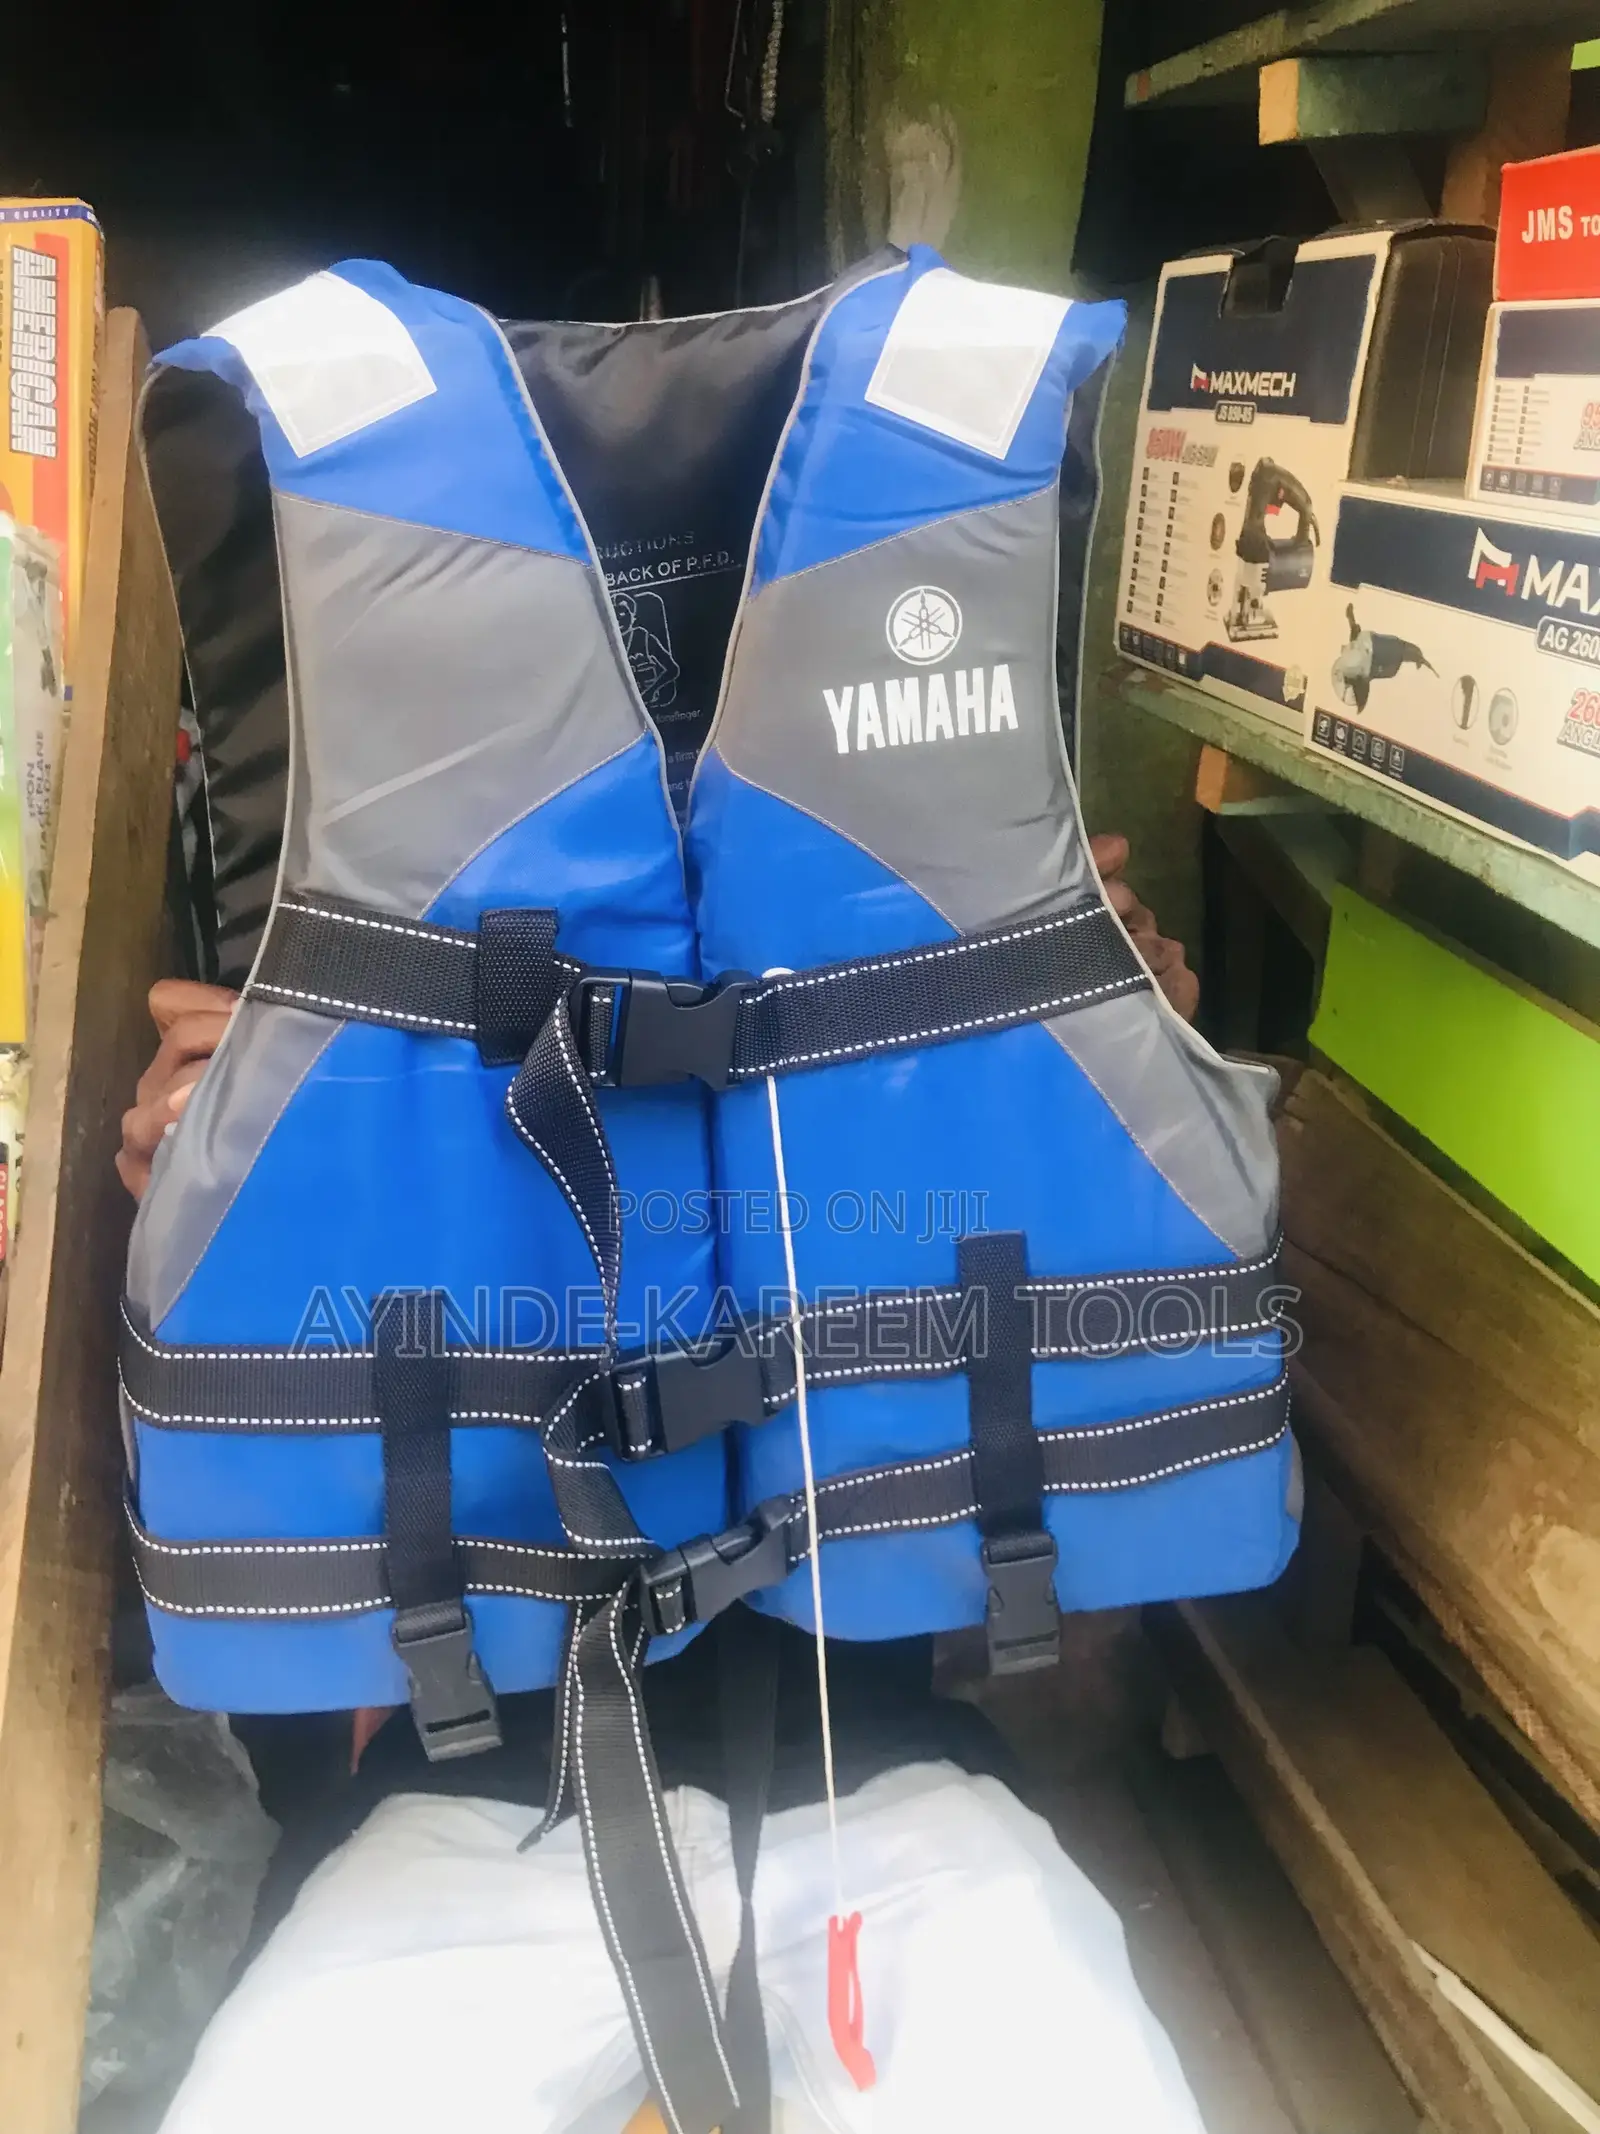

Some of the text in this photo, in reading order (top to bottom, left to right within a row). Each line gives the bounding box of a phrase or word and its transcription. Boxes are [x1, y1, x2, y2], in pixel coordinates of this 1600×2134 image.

[1521, 204, 1573, 244] JMS
[9, 244, 57, 460] AMERICAN
[1210, 371, 1297, 398] MAXMECH
[605, 551, 735, 587] BACK OF P.F.D.
[1541, 624, 1569, 651] AG
[822, 664, 1018, 754] YAMAHA
[36, 731, 44, 795] PLANE
